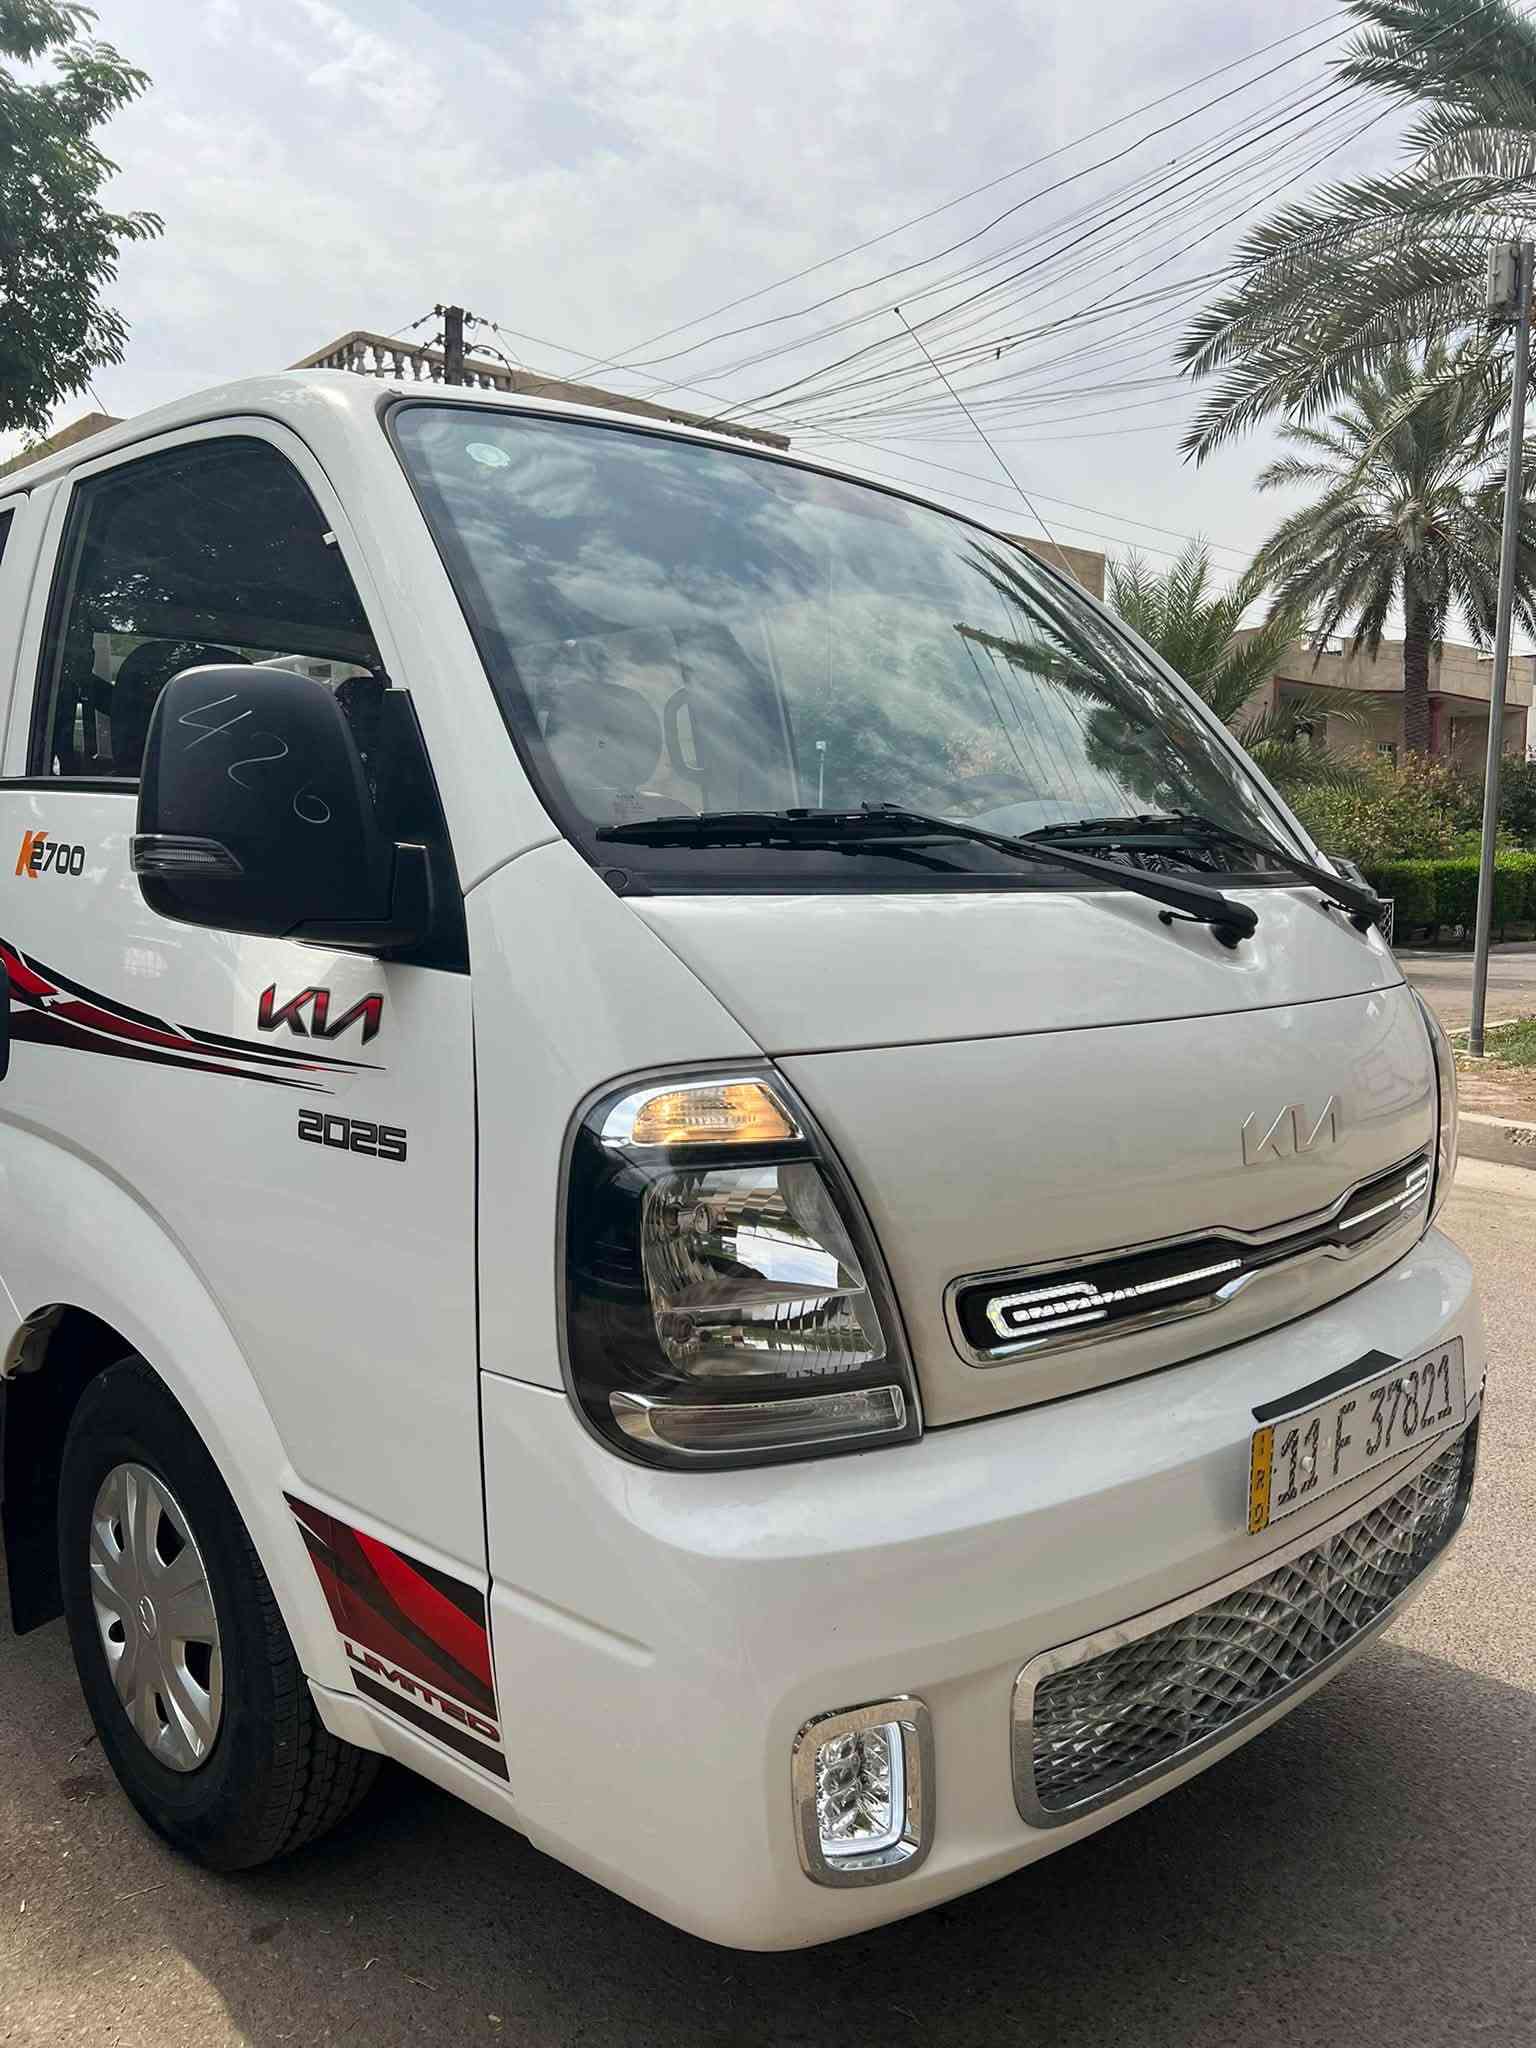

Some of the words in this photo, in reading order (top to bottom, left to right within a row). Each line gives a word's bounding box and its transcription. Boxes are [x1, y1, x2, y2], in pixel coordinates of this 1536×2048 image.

[257, 982, 384, 1046] KIA
[298, 1108, 407, 1162] 2025
[1241, 1095, 1342, 1166] KIA
[1277, 1417, 1321, 1506] 11
[1333, 1400, 1356, 1475] F
[1366, 1354, 1453, 1456] 37821
[343, 1639, 500, 1743] LIMITED
